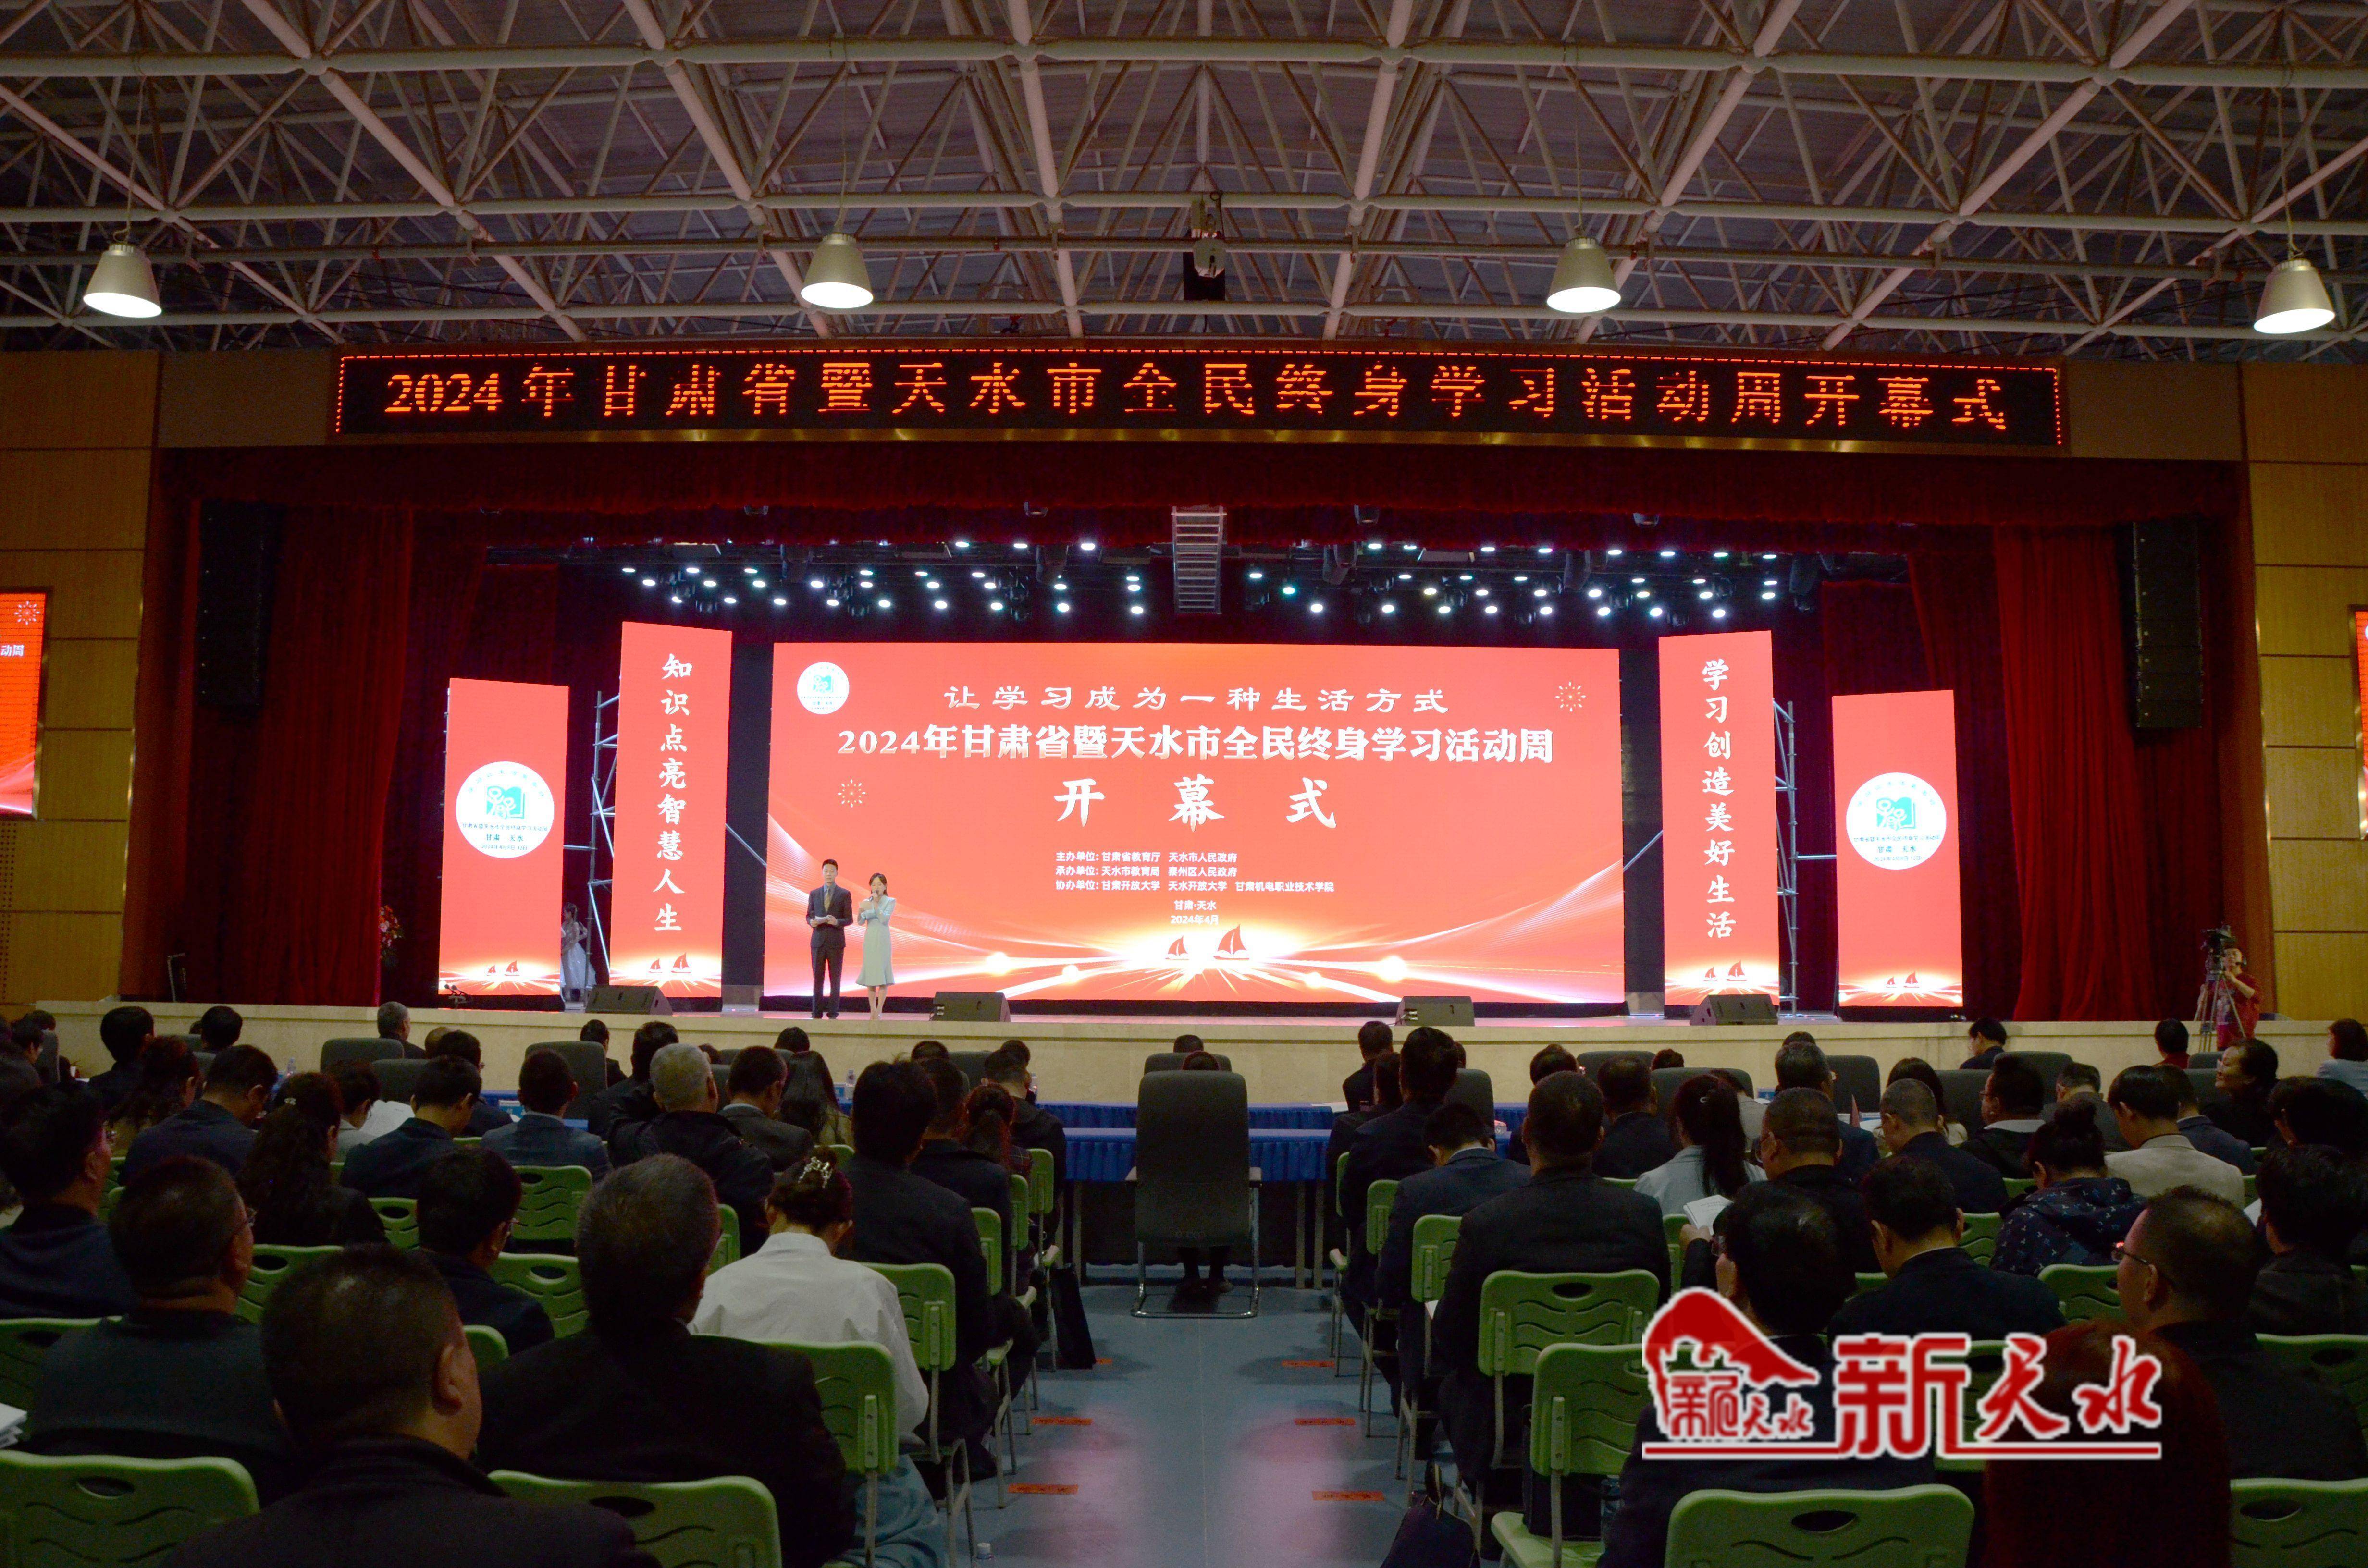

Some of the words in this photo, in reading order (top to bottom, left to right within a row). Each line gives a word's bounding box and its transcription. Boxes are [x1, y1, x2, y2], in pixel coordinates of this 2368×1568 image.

[385, 362, 2007, 430] 2024年甘肃省暨天水市全民终身学习活动周开幕式
[944, 686, 1448, 714] 让学习成为一种生活方式
[838, 724, 1553, 763] 2024年甘肃省暨天水市全民终身学习活动周
[653, 653, 692, 931] 知识点亮智慧人生
[1054, 774, 1336, 832] 开幕式
[1702, 659, 1736, 938] 学习创造美好生活
[1169, 852, 1237, 863] 天水市人民政府
[1169, 880, 1227, 892] 天水开放大学
[1235, 881, 1334, 892] 甘肃机电职业技术学院
[1170, 914, 1219, 925] 2024年4月
